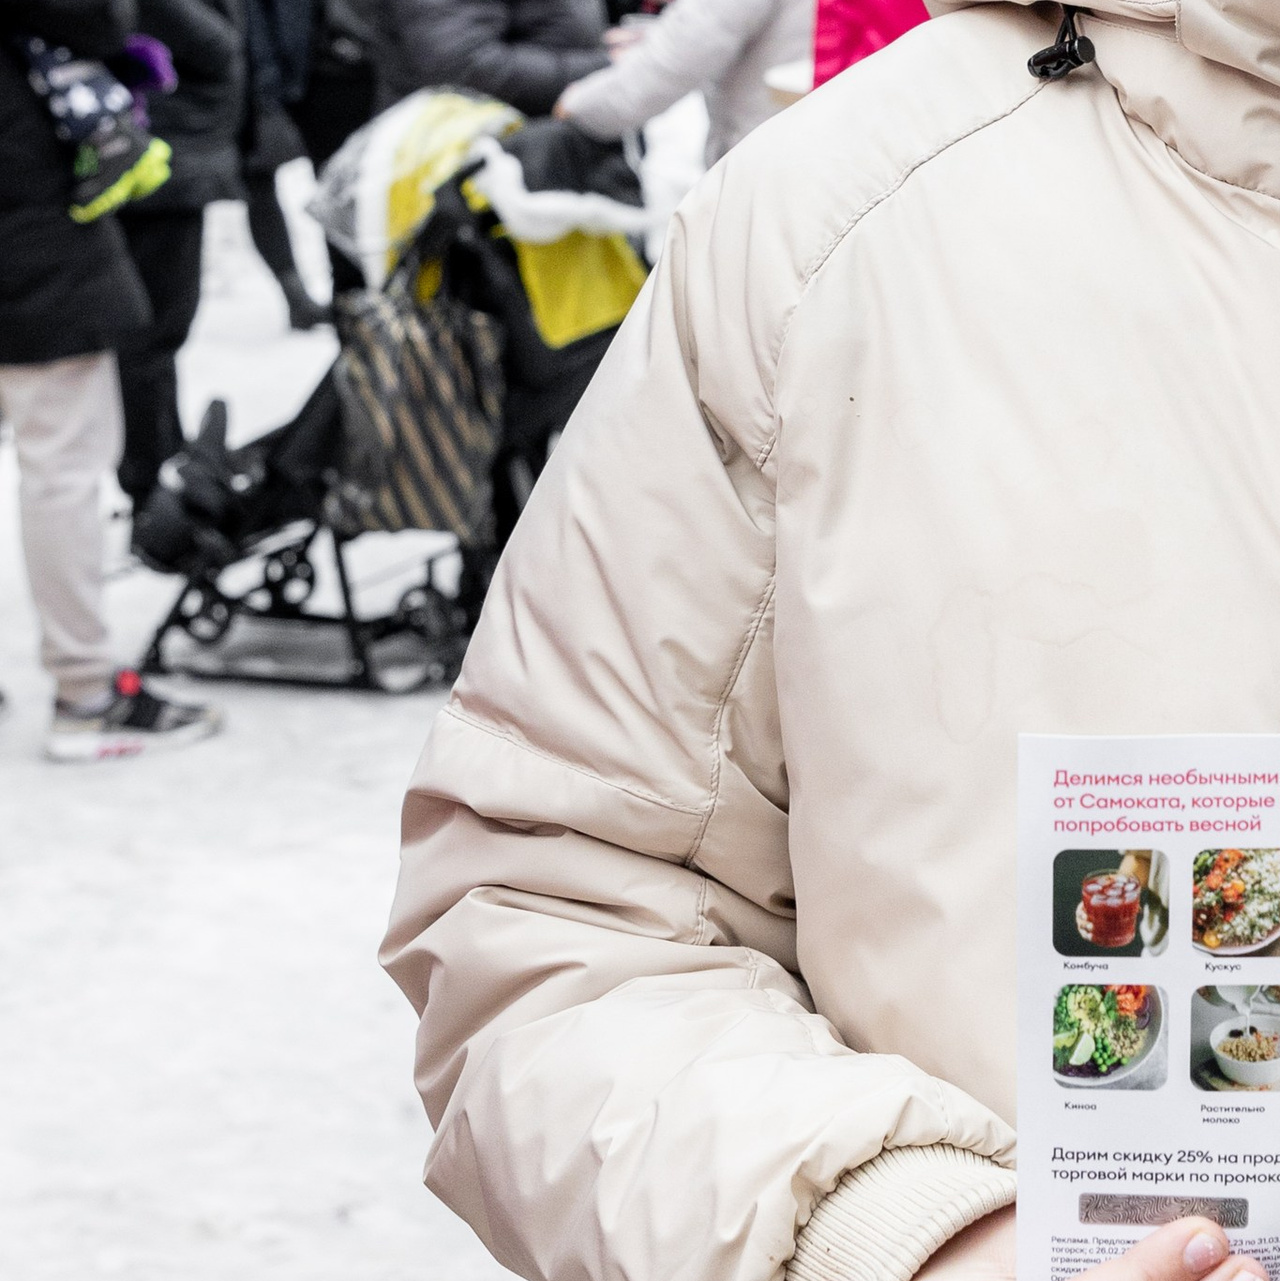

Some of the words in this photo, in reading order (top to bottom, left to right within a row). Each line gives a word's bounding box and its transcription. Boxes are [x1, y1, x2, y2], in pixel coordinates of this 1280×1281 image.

[1053, 769, 1143, 788] Делимся
[1149, 768, 1279, 786] необычными
[1053, 796, 1075, 809] от
[1079, 793, 1186, 812] Самоката,
[1191, 796, 1276, 812] которые
[1053, 815, 1184, 837] попробовать
[1188, 814, 1262, 832] весной
[1063, 961, 1109, 971] Комбуча
[1204, 962, 1242, 972] Кускус
[1064, 1101, 1097, 1111] Киноа
[1202, 1116, 1240, 1125] молоко
[1051, 1147, 1109, 1164] Дарим
[1112, 1150, 1173, 1166] скидку
[1177, 1150, 1213, 1164] 25%
[1217, 1152, 1239, 1164] на
[1051, 1167, 1127, 1183] торговой
[1131, 1171, 1184, 1185] марки
[1189, 1172, 1210, 1183] по
